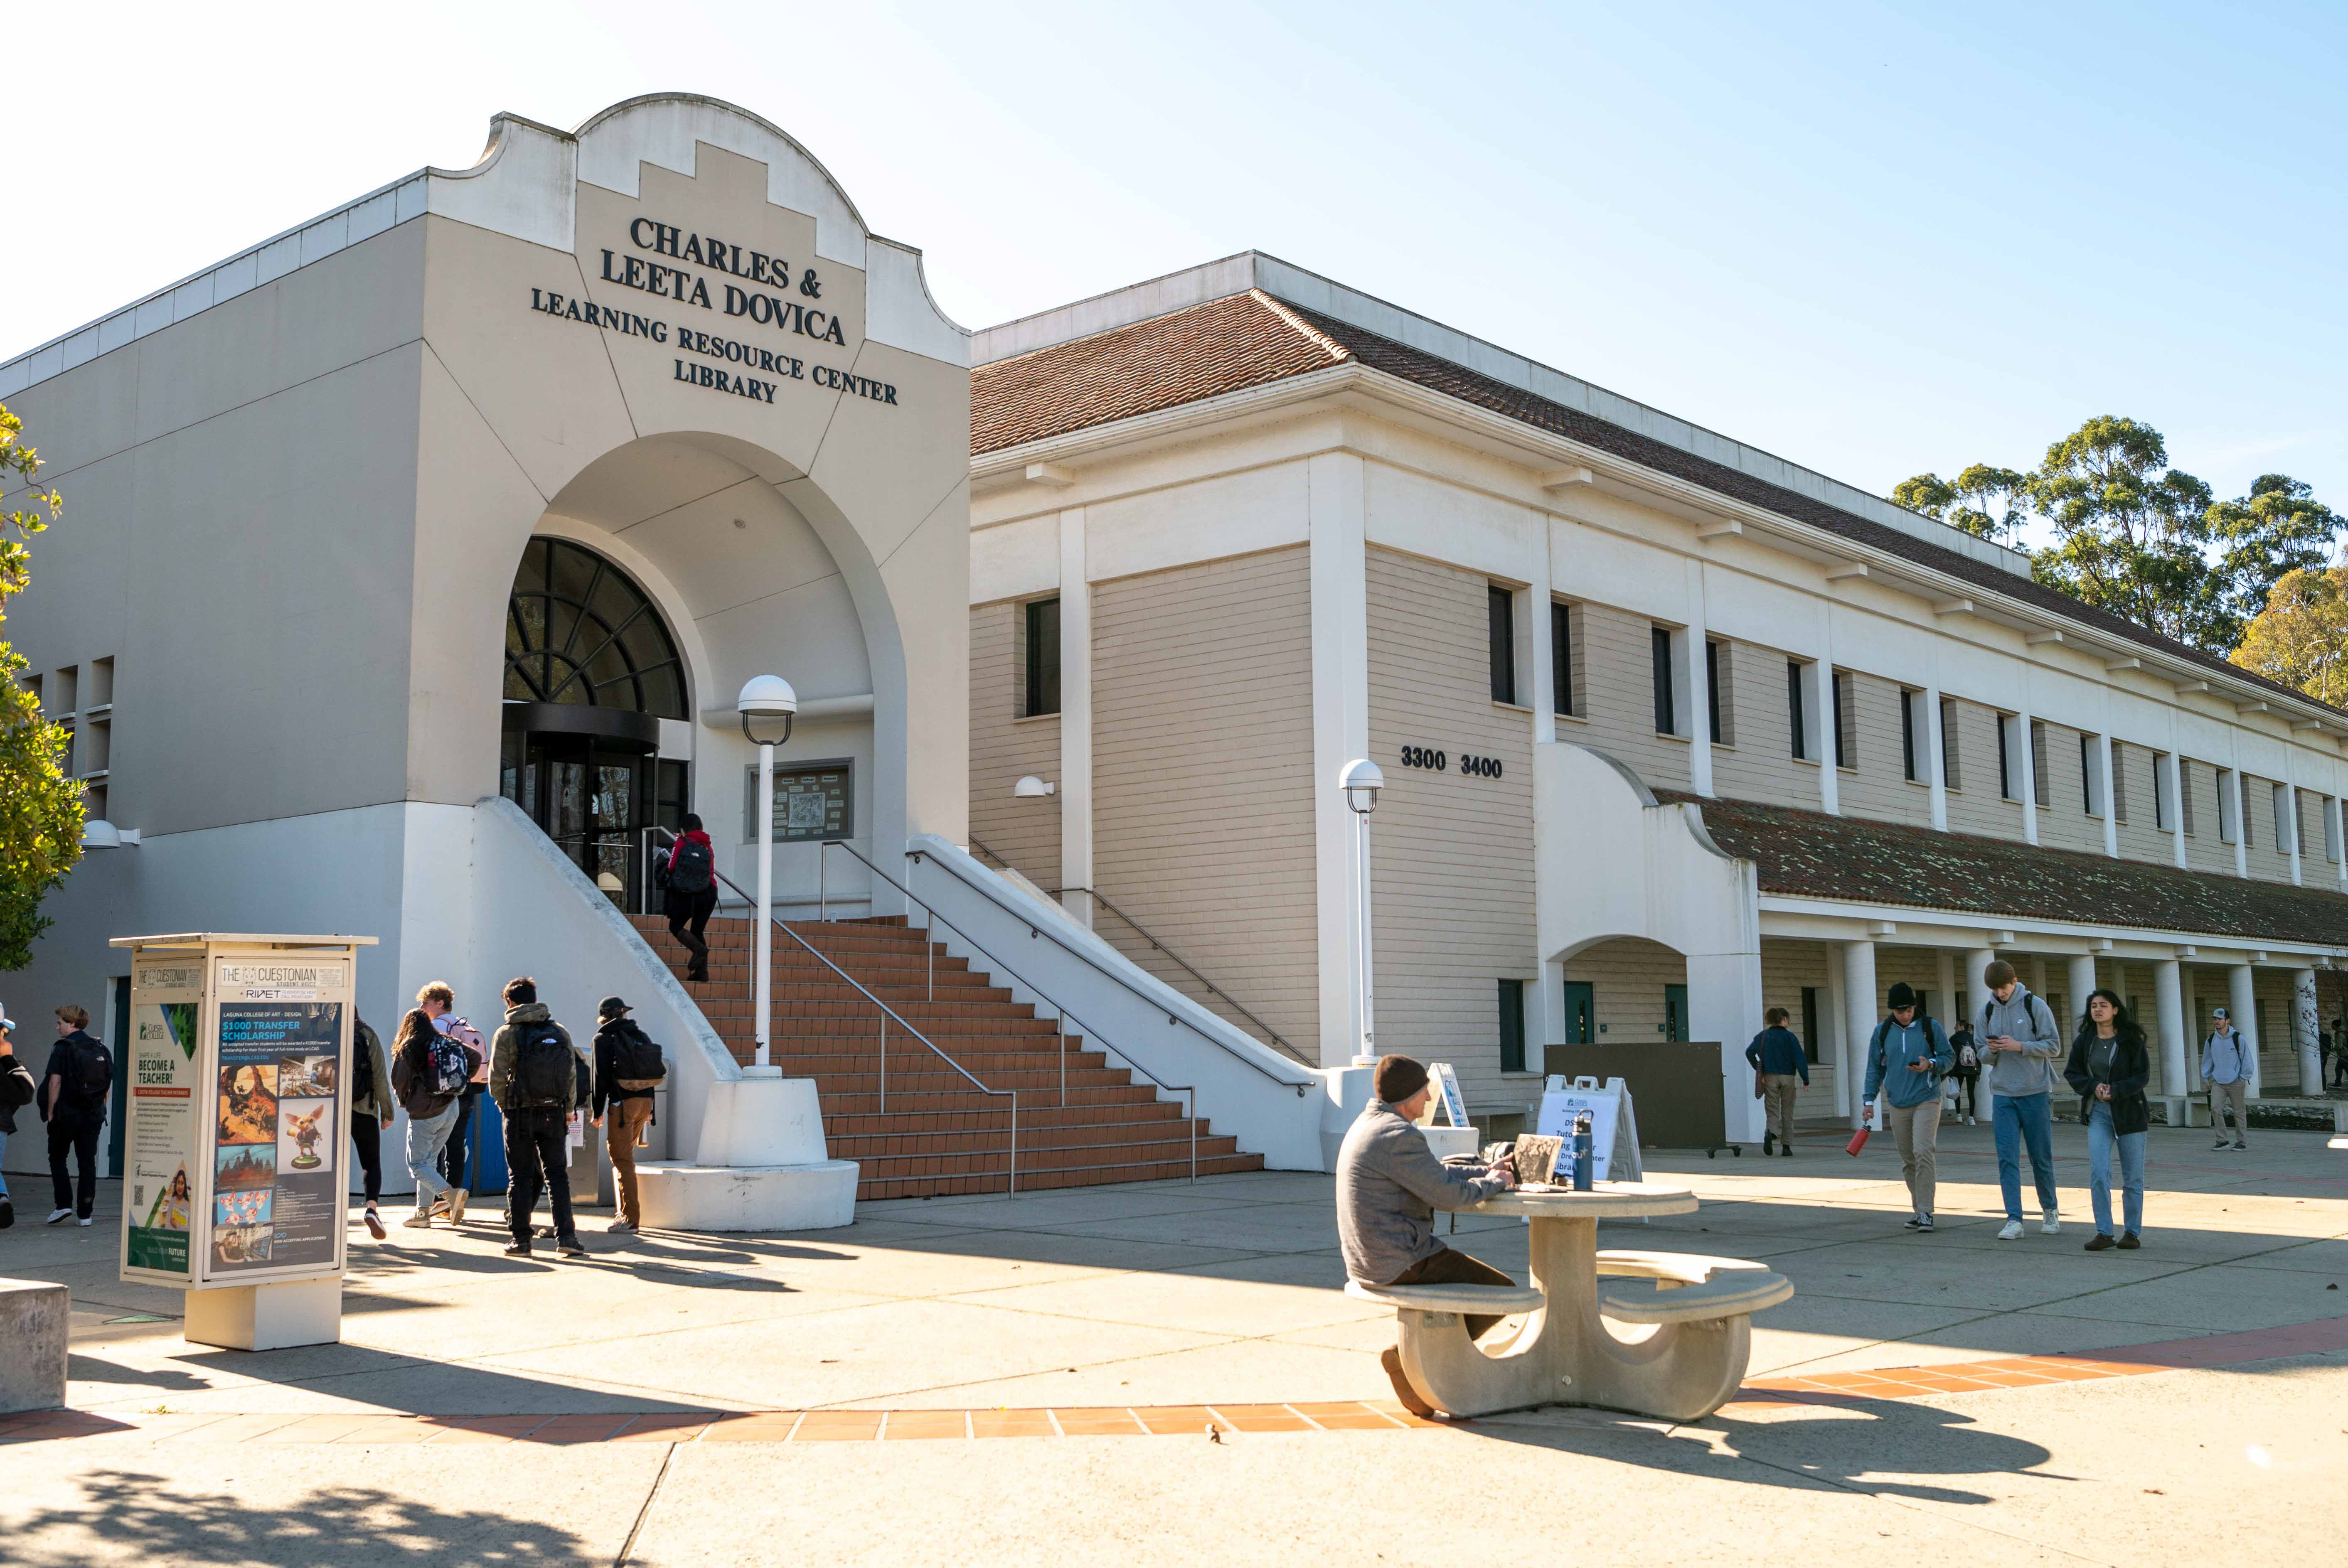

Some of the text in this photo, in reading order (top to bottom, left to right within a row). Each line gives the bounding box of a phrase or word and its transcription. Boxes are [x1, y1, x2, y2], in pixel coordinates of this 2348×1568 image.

[630, 217, 822, 299] CHARLES &
[601, 249, 846, 346] LEETA DOVICA
[532, 288, 898, 406] LEARNING RESOURCE CENTER
[674, 359, 777, 404] LIBRARY
[1402, 745, 1502, 778] 3300 3400
[139, 970, 147, 983] THE
[156, 968, 187, 982] CUESTONIAN
[222, 968, 239, 981] THE
[258, 968, 316, 981] CUESTONIAN
[148, 1024, 163, 1032] CUESTA
[223, 1021, 300, 1030] $1000 TRANSFER
[146, 1032, 165, 1040] COLLEGE
[222, 1032, 286, 1040] SCHOLARSHIP
[139, 1060, 175, 1071] BECOME A
[138, 1073, 172, 1084] TEACHER!
[169, 1247, 186, 1257] FUTURE
